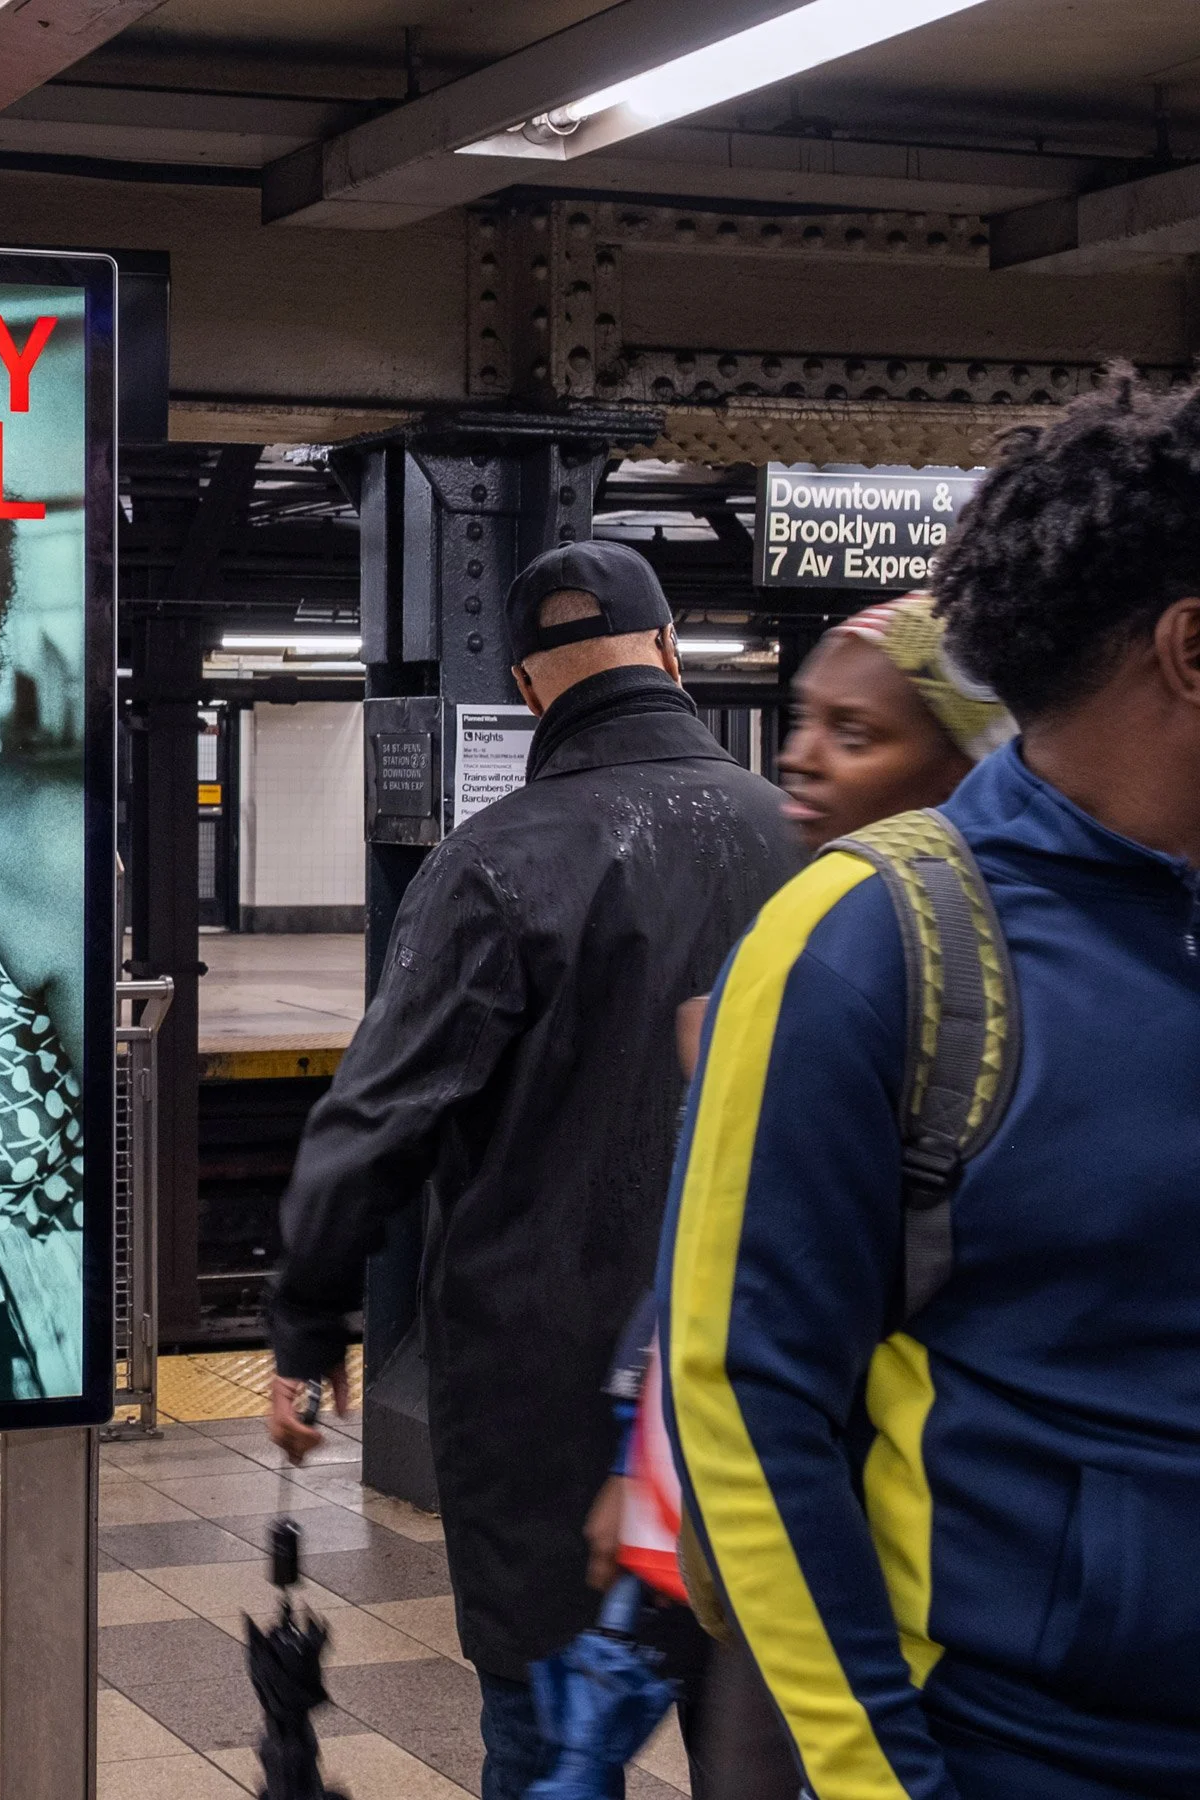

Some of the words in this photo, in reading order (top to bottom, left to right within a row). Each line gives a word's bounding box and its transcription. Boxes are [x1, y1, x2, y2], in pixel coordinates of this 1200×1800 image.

[771, 478, 921, 511] Downtown
[932, 483, 953, 512] &
[769, 512, 896, 550] Brooklyn
[907, 516, 947, 546] via
[769, 546, 788, 576] 7
[797, 547, 833, 577] Av
[474, 732, 504, 744] Nights
[383, 756, 410, 766] STATION
[383, 769, 421, 778] DOWNTOWN
[463, 772, 487, 781] Trains
[488, 773, 500, 781] will
[461, 783, 504, 792] Chambers
